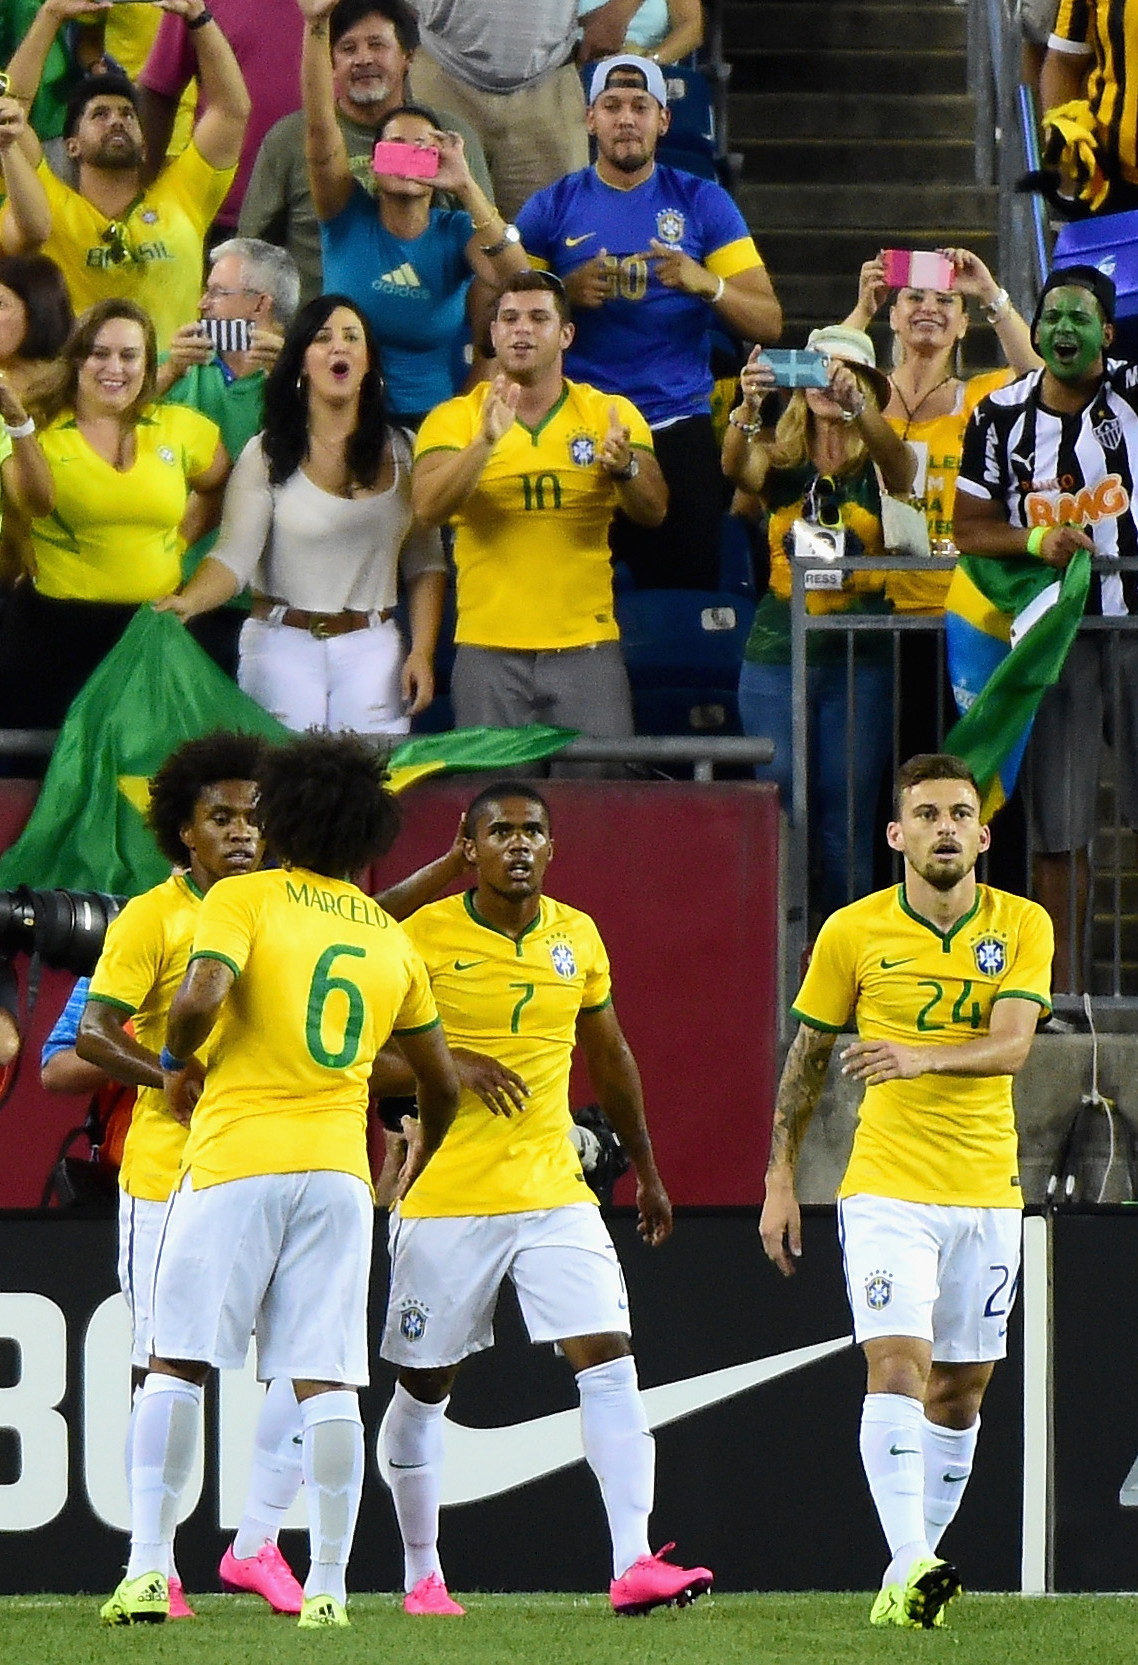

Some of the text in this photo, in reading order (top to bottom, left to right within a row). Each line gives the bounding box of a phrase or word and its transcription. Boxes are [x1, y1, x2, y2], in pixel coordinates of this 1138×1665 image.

[371, 277, 431, 300] adidas
[520, 472, 562, 511] 10
[286, 880, 389, 930] MARCELO
[305, 943, 367, 1070] 6
[508, 983, 535, 1034] 7
[916, 979, 981, 1032] 24
